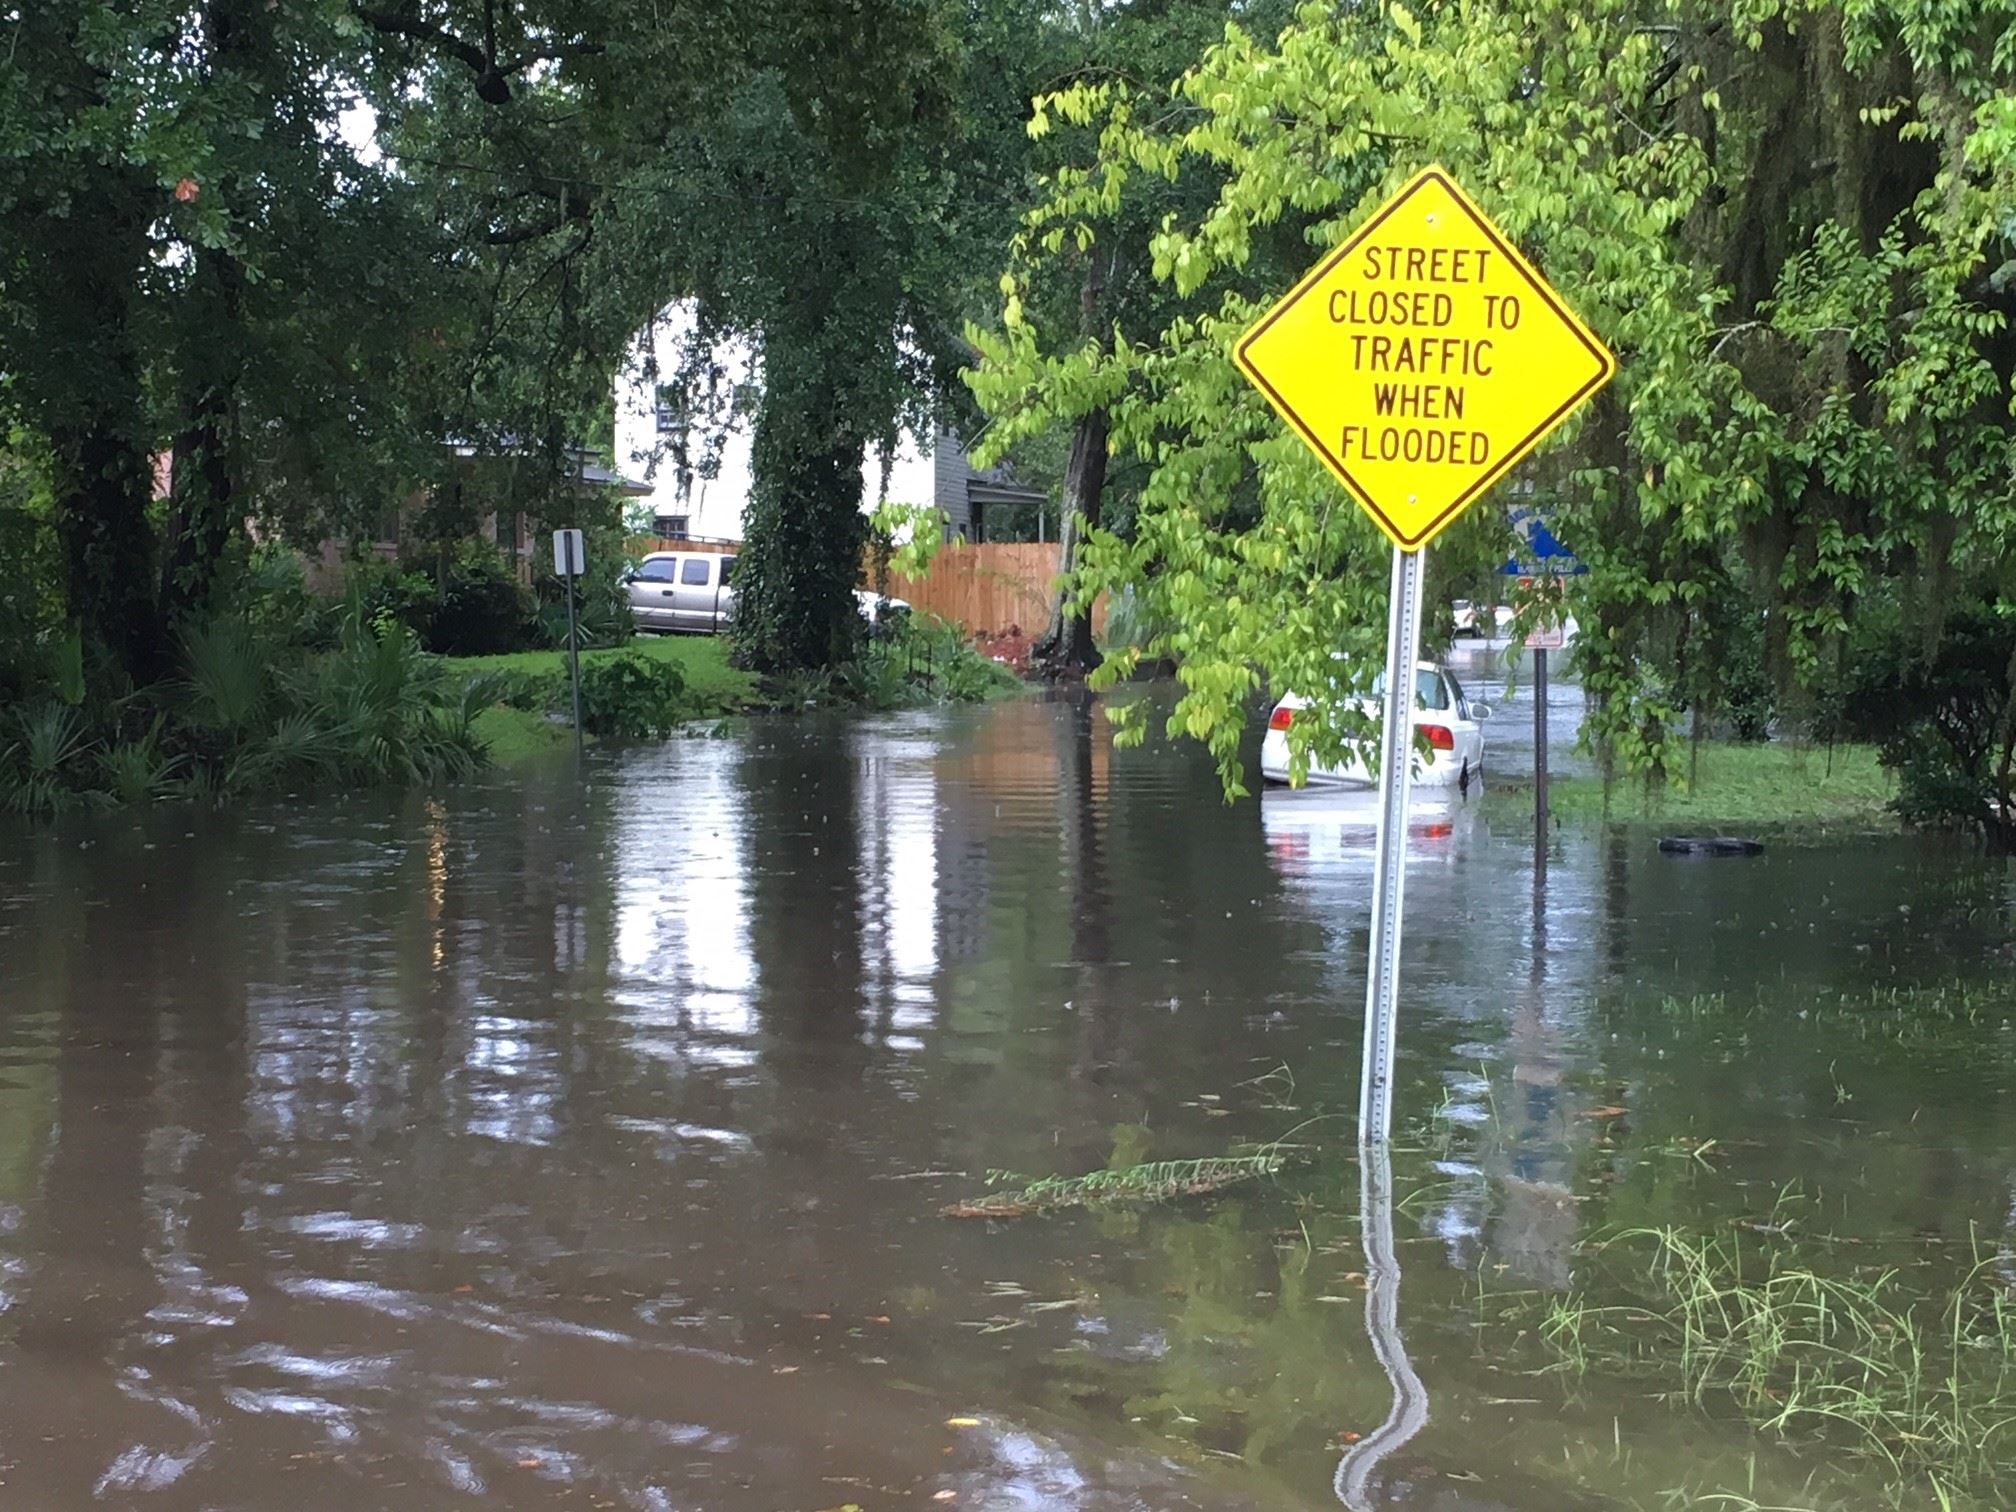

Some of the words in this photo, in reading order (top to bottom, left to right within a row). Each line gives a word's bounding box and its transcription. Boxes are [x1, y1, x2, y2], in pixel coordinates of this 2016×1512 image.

[1363, 246, 1491, 283] STREET
[1329, 289, 1452, 327] CLOSED
[1483, 296, 1520, 330] TO
[1351, 335, 1493, 377] TRAFFIC
[1374, 383, 1464, 420] WHEN
[1341, 426, 1489, 465] FLOODED
